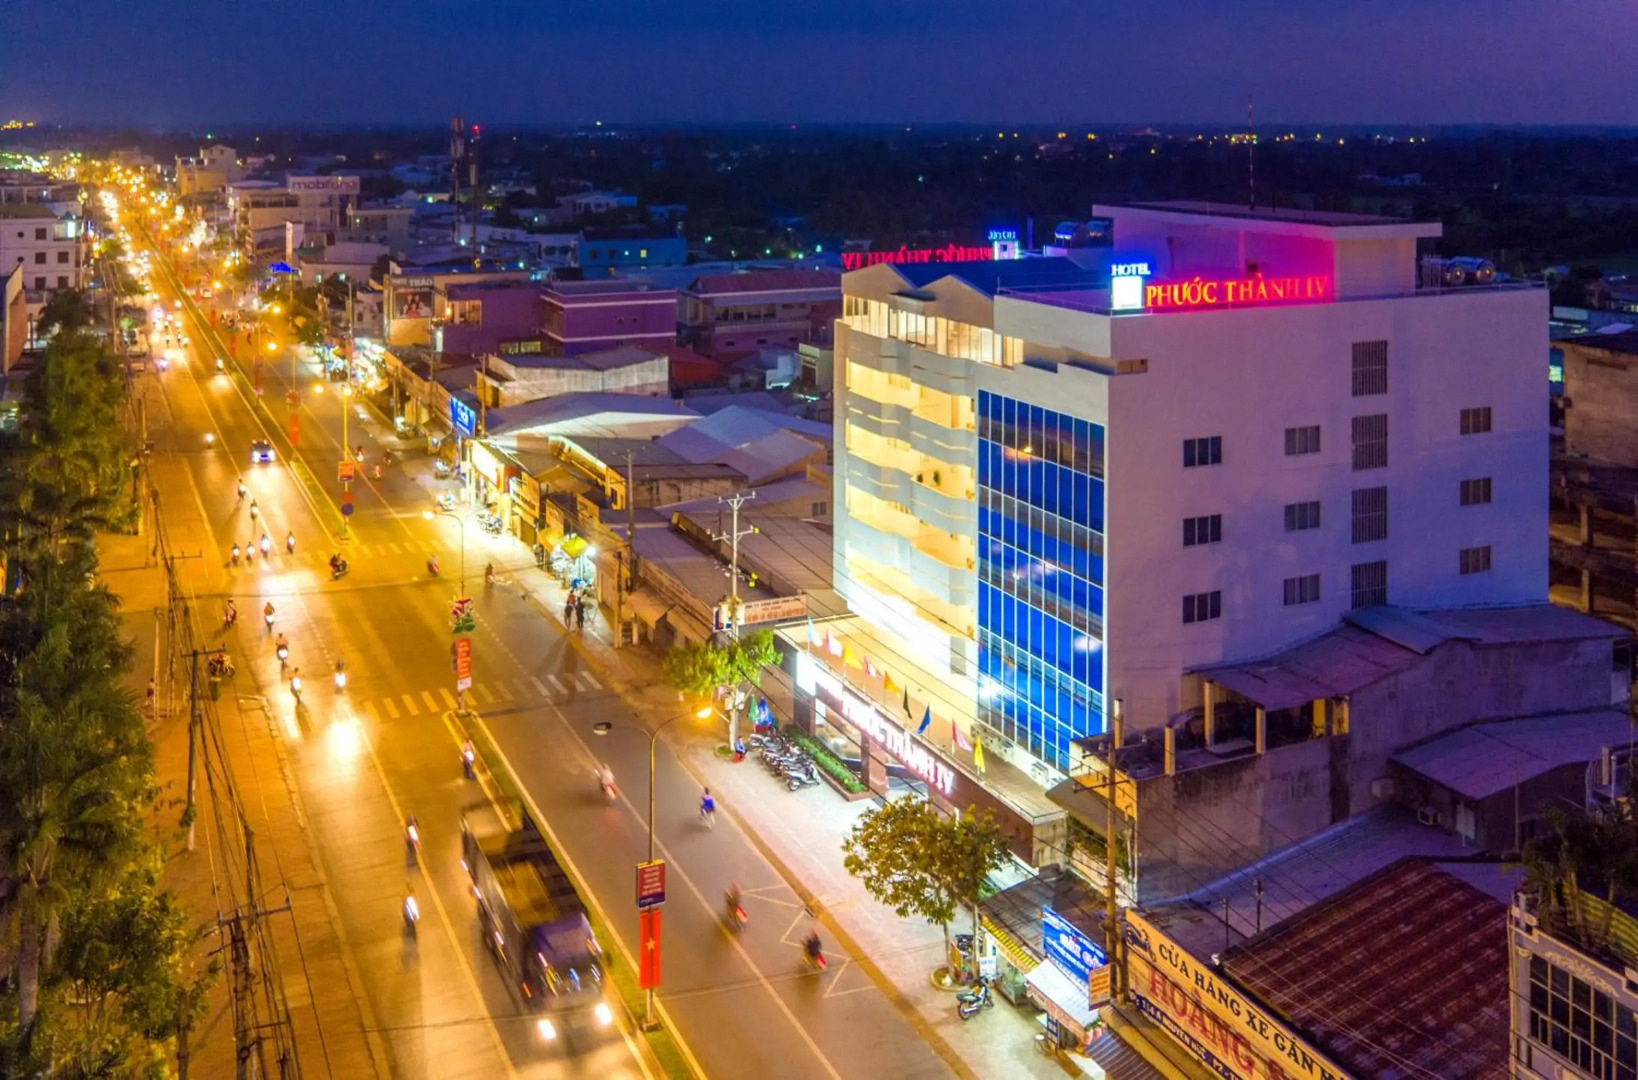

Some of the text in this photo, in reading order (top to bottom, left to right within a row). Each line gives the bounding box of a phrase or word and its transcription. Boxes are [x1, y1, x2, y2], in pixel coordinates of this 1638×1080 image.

[1111, 262, 1151, 276] HOTEL
[1145, 272, 1329, 307] PHƯỚC THÀNH IV
[935, 761, 955, 795] IV
[1158, 943, 1190, 979] CỬA
[1194, 969, 1241, 1018] HÀNG
[1246, 1009, 1270, 1041] XE
[1149, 968, 1256, 1077] HOÀNG
